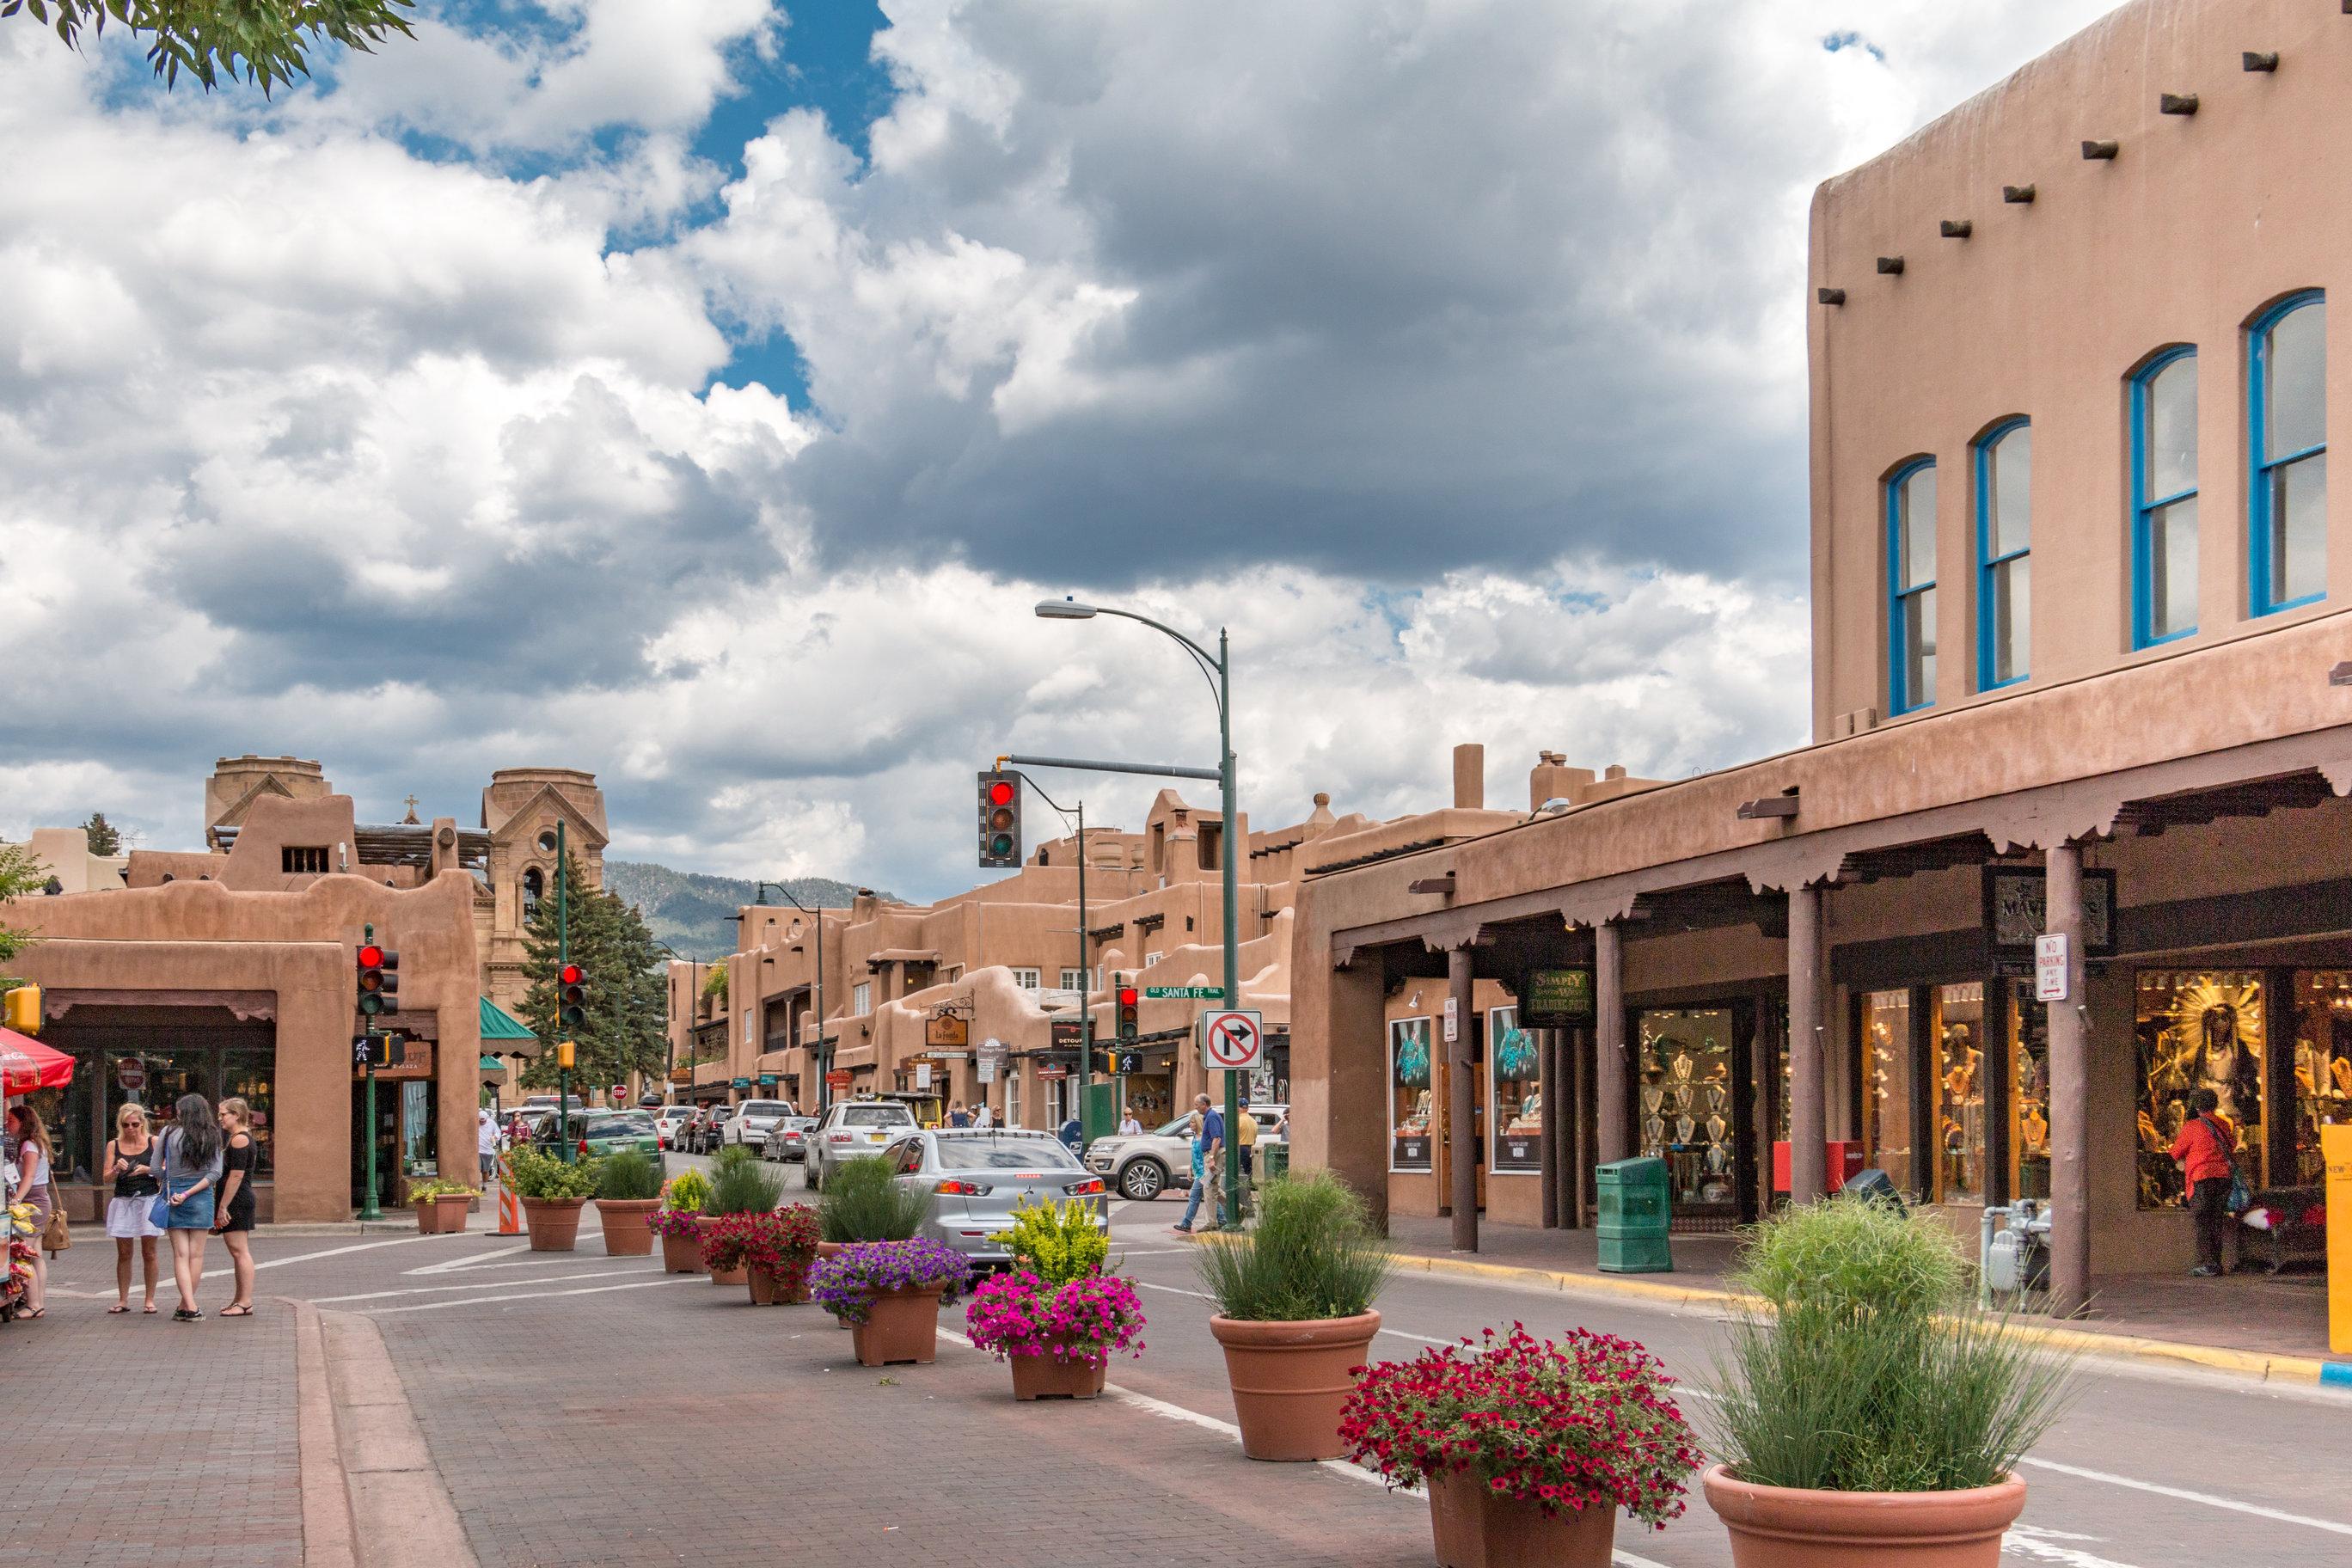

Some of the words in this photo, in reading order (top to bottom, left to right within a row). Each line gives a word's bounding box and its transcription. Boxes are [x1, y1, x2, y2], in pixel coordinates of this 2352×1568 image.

[2046, 940, 2056, 952] NO
[2038, 954, 2064, 967] PARKING
[2044, 977, 2059, 986] TIME
[1162, 987, 1189, 997] SANTA
[1193, 988, 1204, 997] FE
